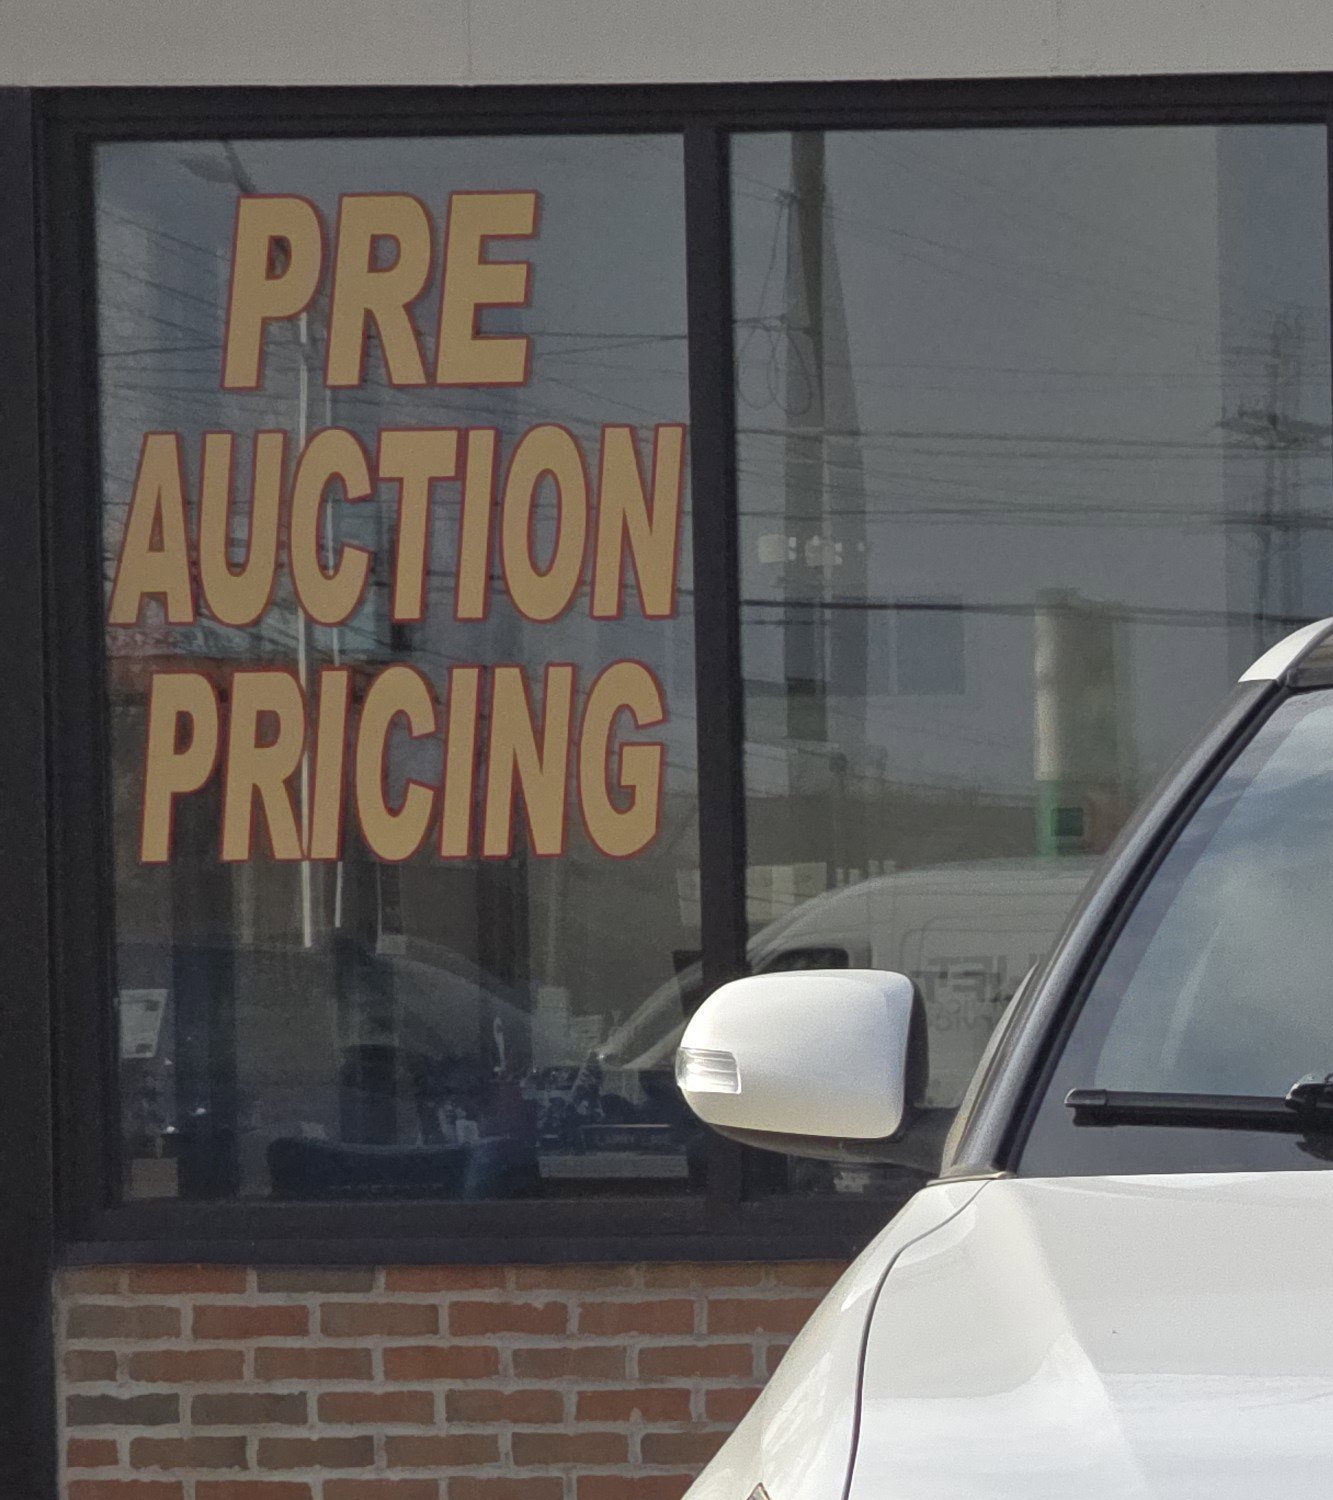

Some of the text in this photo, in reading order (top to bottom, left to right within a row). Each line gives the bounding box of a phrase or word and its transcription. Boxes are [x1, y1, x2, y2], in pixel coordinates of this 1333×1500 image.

[221, 189, 542, 390] PRE
[109, 422, 687, 628] AUCTION
[139, 659, 667, 864] PRICING
